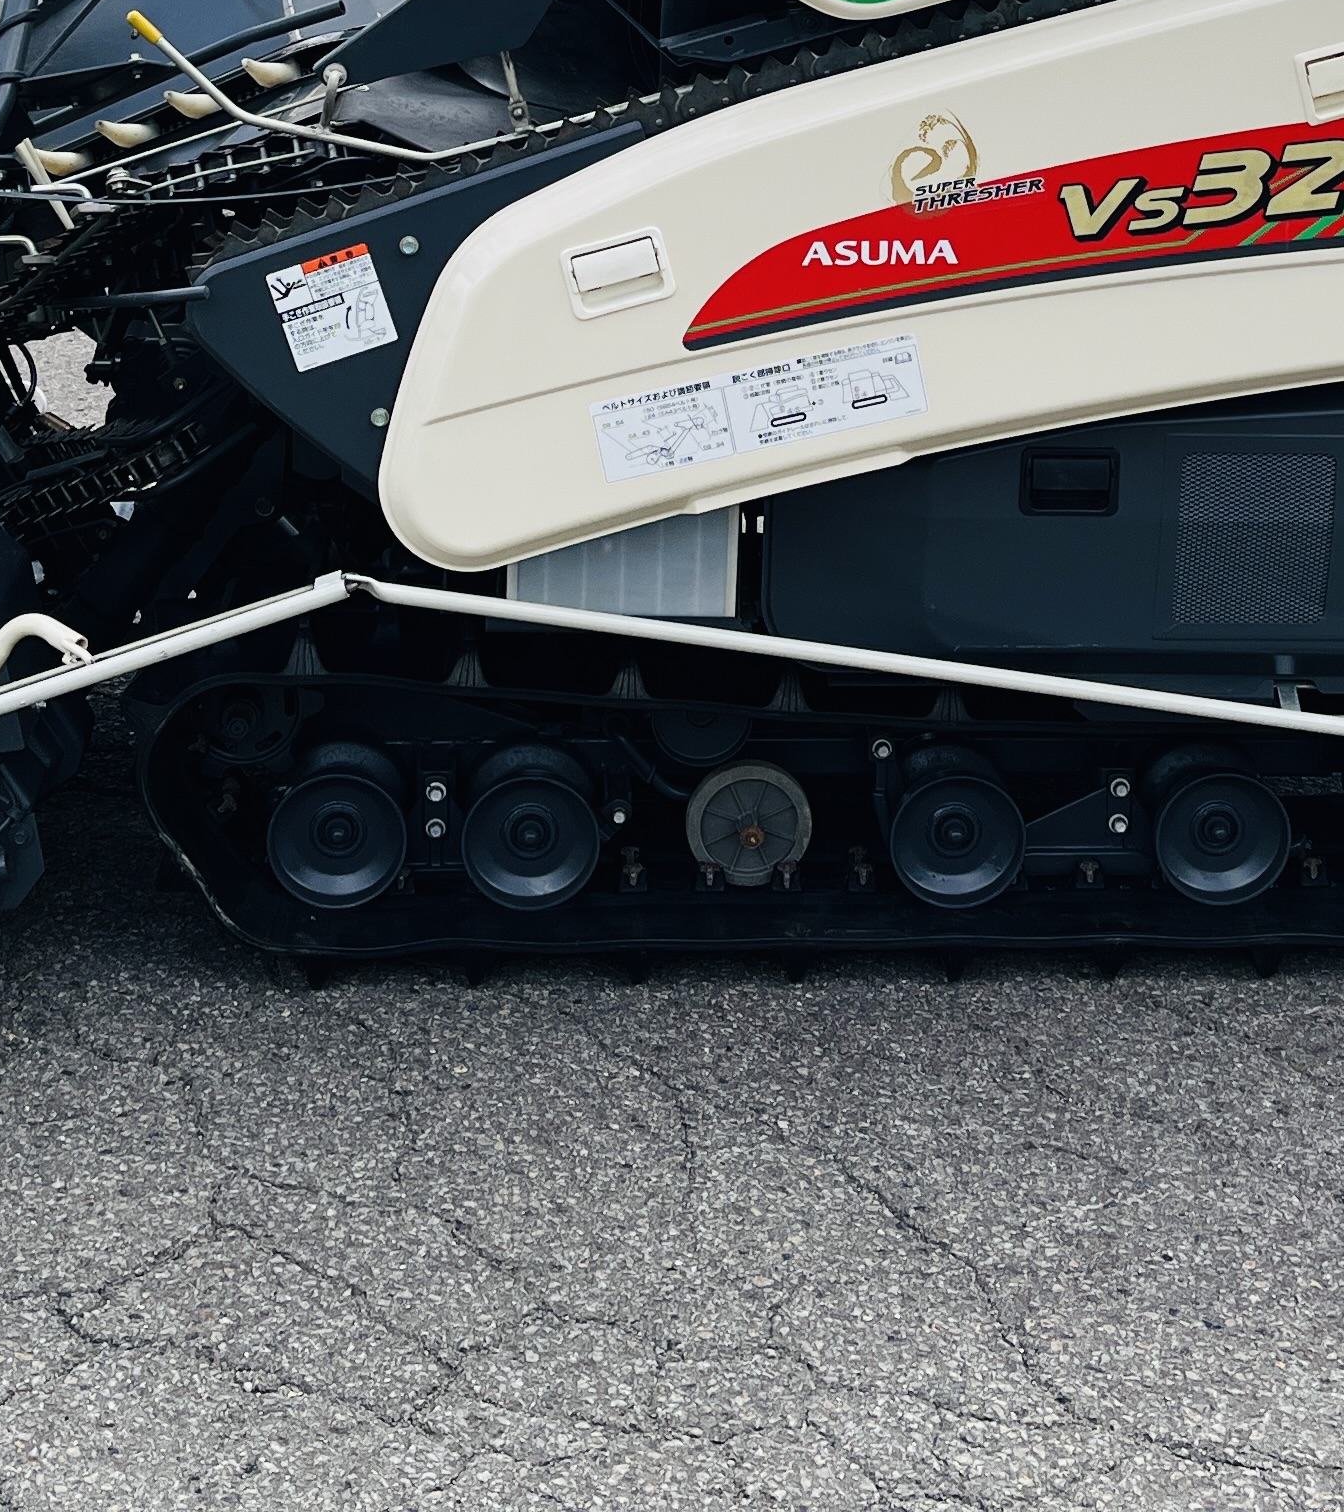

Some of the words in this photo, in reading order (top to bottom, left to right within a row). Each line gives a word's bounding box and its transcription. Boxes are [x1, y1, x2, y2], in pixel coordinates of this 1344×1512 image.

[913, 178, 1044, 213] THRESHER
[915, 177, 976, 197] SUPER
[801, 239, 959, 266] ASUMA
